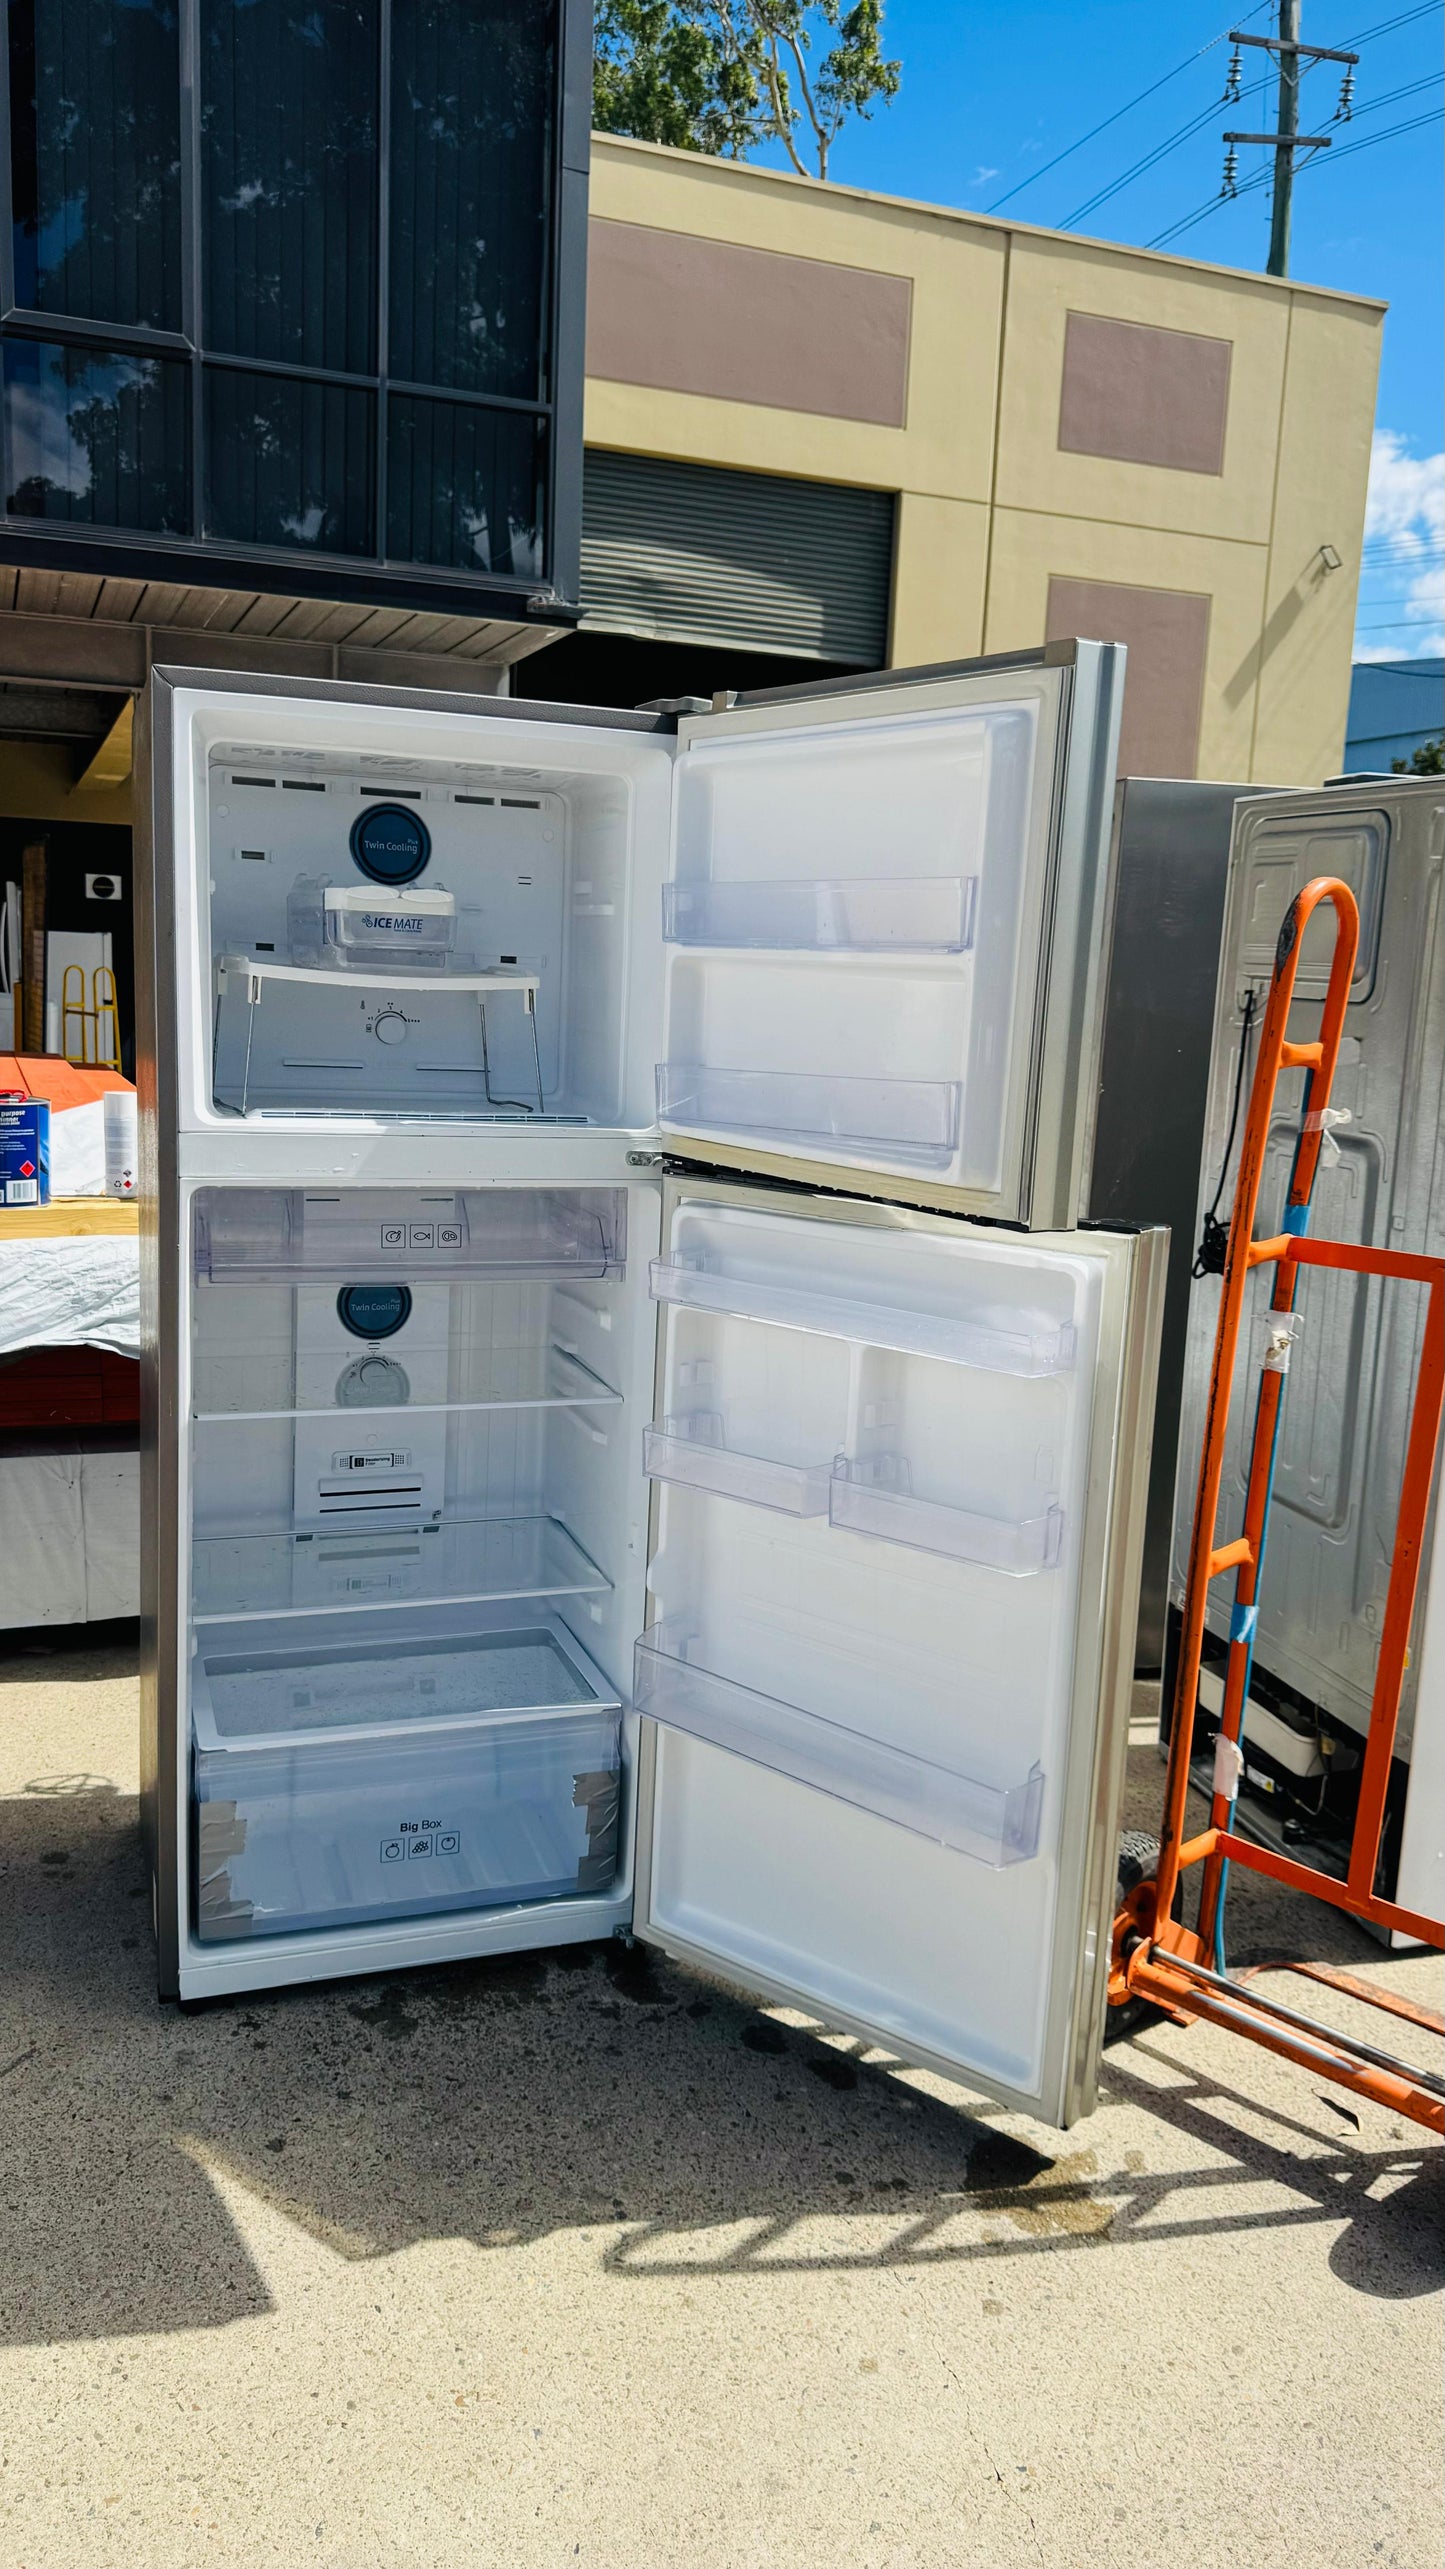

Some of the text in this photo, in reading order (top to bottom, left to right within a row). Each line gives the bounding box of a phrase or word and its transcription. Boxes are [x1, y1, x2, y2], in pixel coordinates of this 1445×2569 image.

[364, 840, 385, 850] Twin
[386, 842, 418, 855] Cooling
[374, 917, 424, 930] ICE MATE
[351, 1303, 370, 1311] Twin
[371, 1302, 400, 1312] Cooling
[400, 1820, 442, 1833] Big Box
